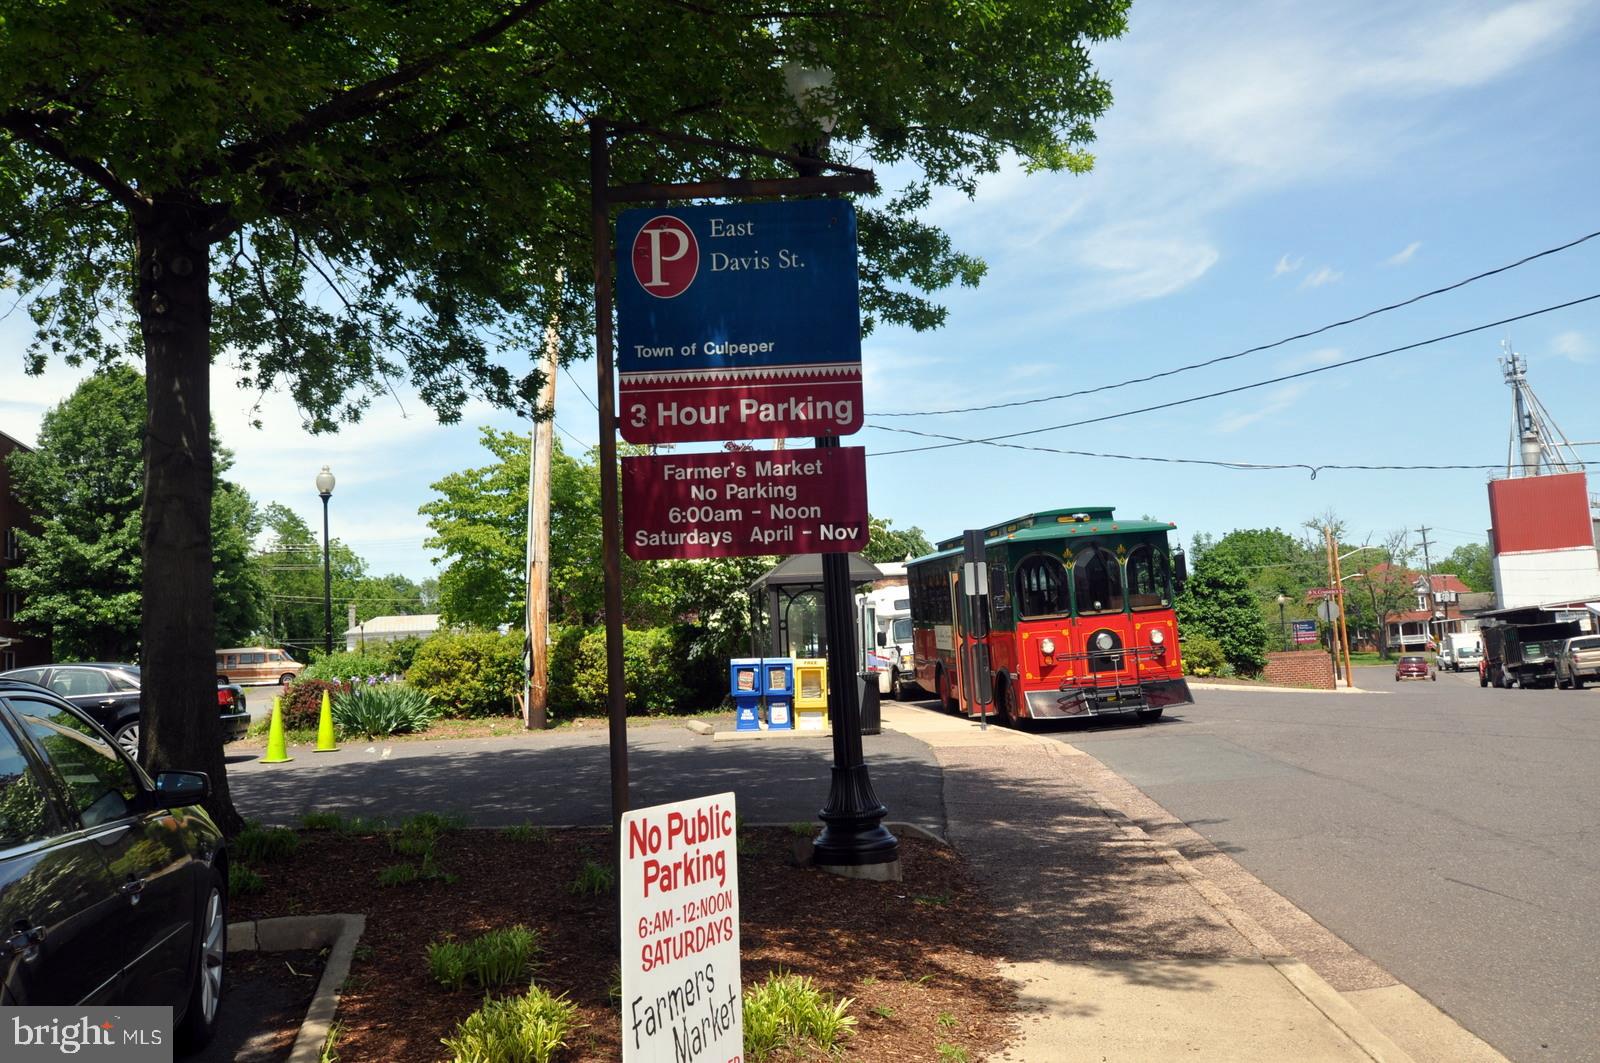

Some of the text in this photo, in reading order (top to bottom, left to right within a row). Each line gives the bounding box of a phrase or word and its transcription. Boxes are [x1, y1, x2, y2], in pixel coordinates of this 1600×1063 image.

[709, 218, 754, 238] East
[643, 228, 689, 286] P
[710, 249, 805, 272] Davis St.
[634, 340, 775, 358] Town of Culpeper
[630, 396, 853, 428] 3 Hour Parking
[664, 459, 823, 481] Farmer's Market
[691, 482, 797, 501] No Parking
[668, 506, 743, 524] 6:00am
[770, 504, 821, 520] Noon
[635, 529, 733, 547] Saturdays
[750, 525, 794, 544] April
[820, 523, 859, 541] Nov
[629, 804, 732, 859] No Public
[643, 849, 726, 898] Parking
[641, 916, 733, 972] SATURDAYS
[632, 963, 716, 1050] Farmers
[672, 983, 737, 1063] Market
